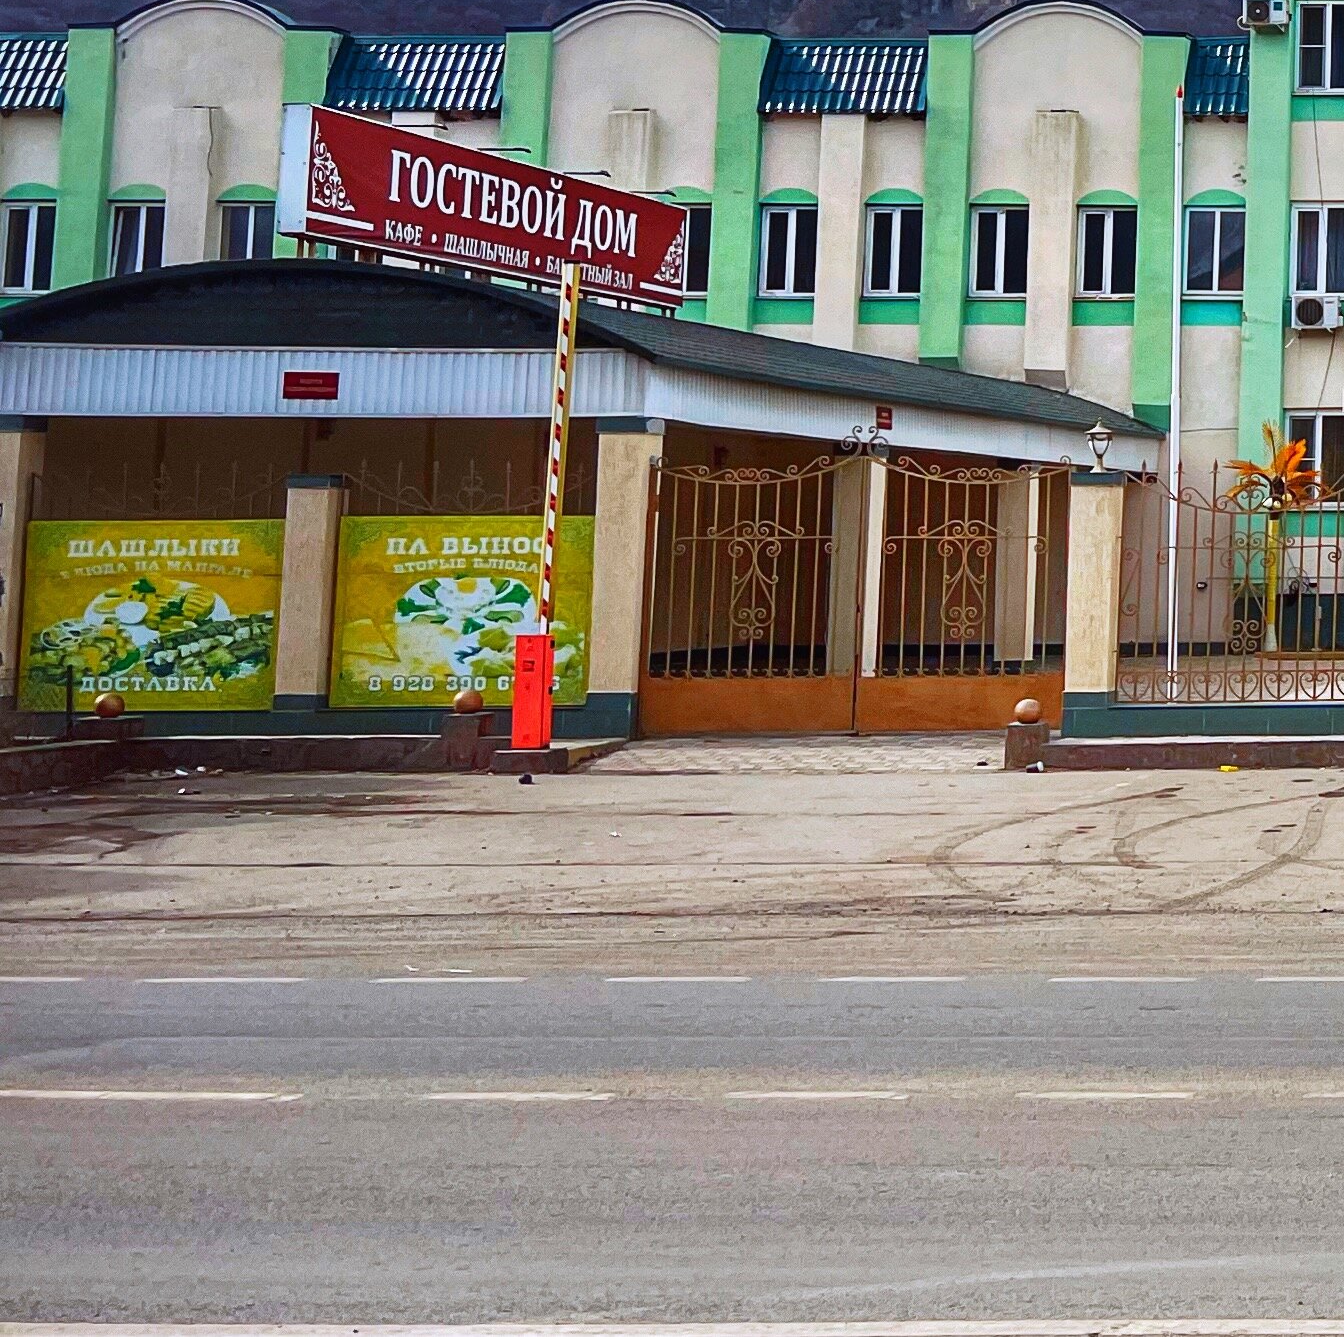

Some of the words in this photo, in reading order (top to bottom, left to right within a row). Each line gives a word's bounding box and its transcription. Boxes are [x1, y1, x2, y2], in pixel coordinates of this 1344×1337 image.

[388, 148, 565, 241] ГОСТЕВОЙ
[570, 199, 638, 259] ДОМ
[384, 219, 424, 246] КАФЕ
[443, 233, 530, 269] ШАШЛЫЧНАЯ
[546, 255, 613, 286] БАТНЫЙ
[613, 270, 633, 290] ЗАЛ
[67, 539, 241, 558] ШАШЛЫКИ
[442, 536, 543, 555] ВЫНОС
[368, 676, 382, 691] 8
[393, 676, 435, 691] 928
